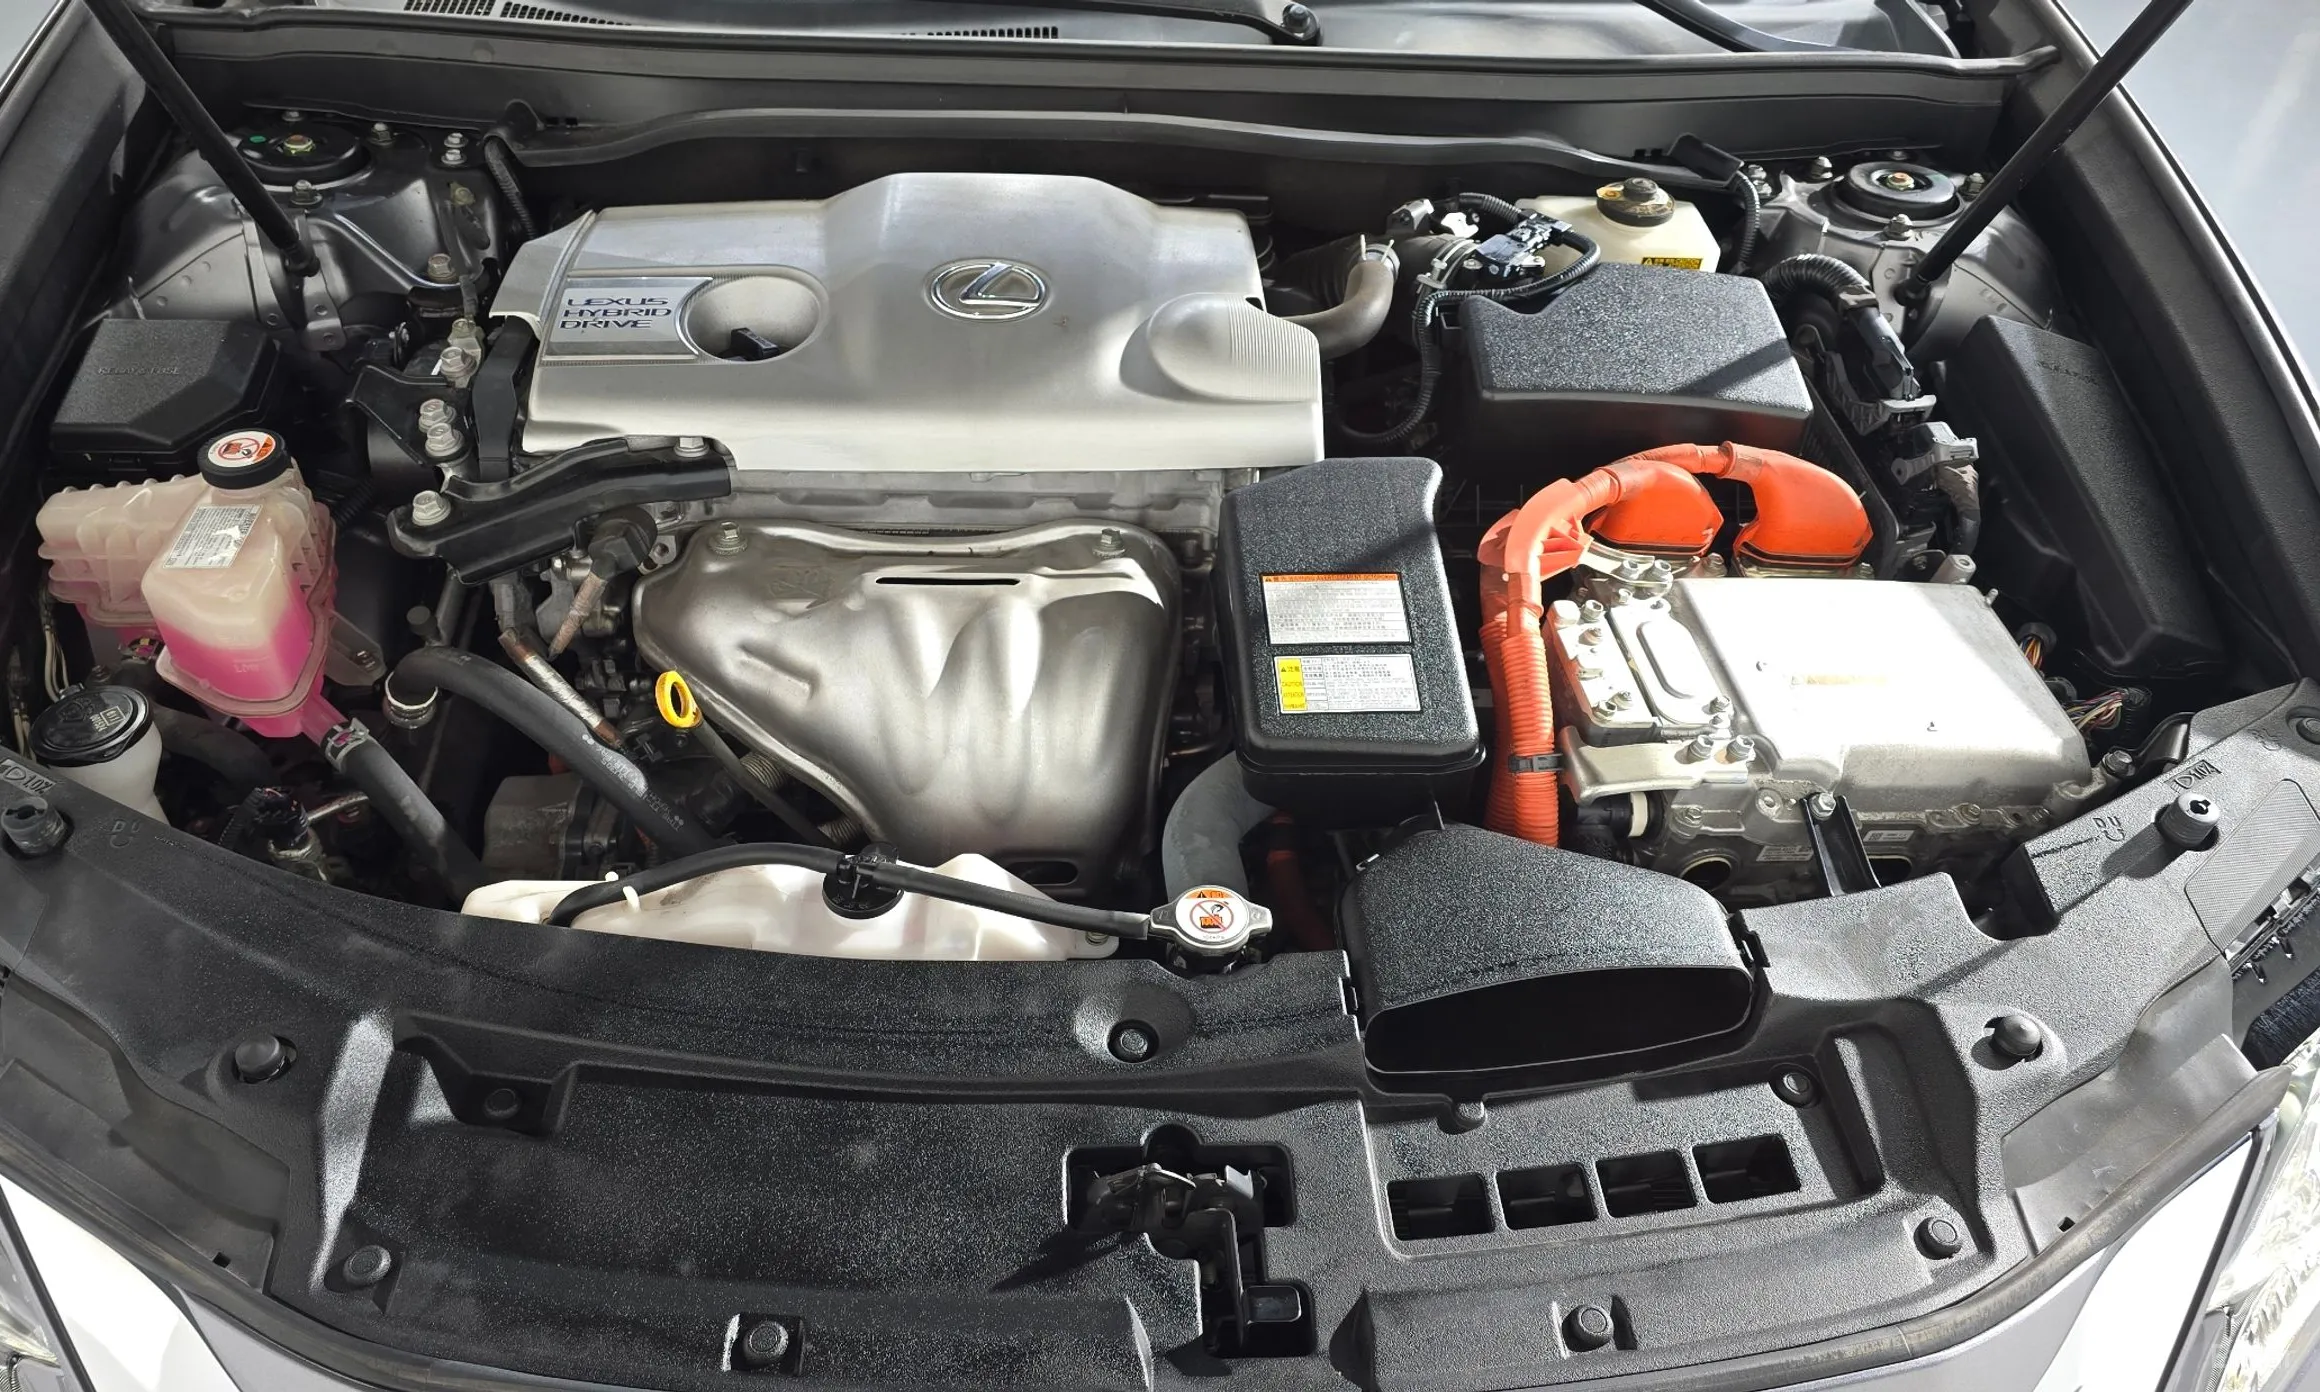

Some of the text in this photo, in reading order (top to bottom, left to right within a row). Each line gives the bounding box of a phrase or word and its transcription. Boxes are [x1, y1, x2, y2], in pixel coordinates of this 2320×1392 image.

[567, 297, 669, 306] LEXUS
[563, 308, 672, 317] HYBRID
[560, 319, 653, 329] DRIVE
